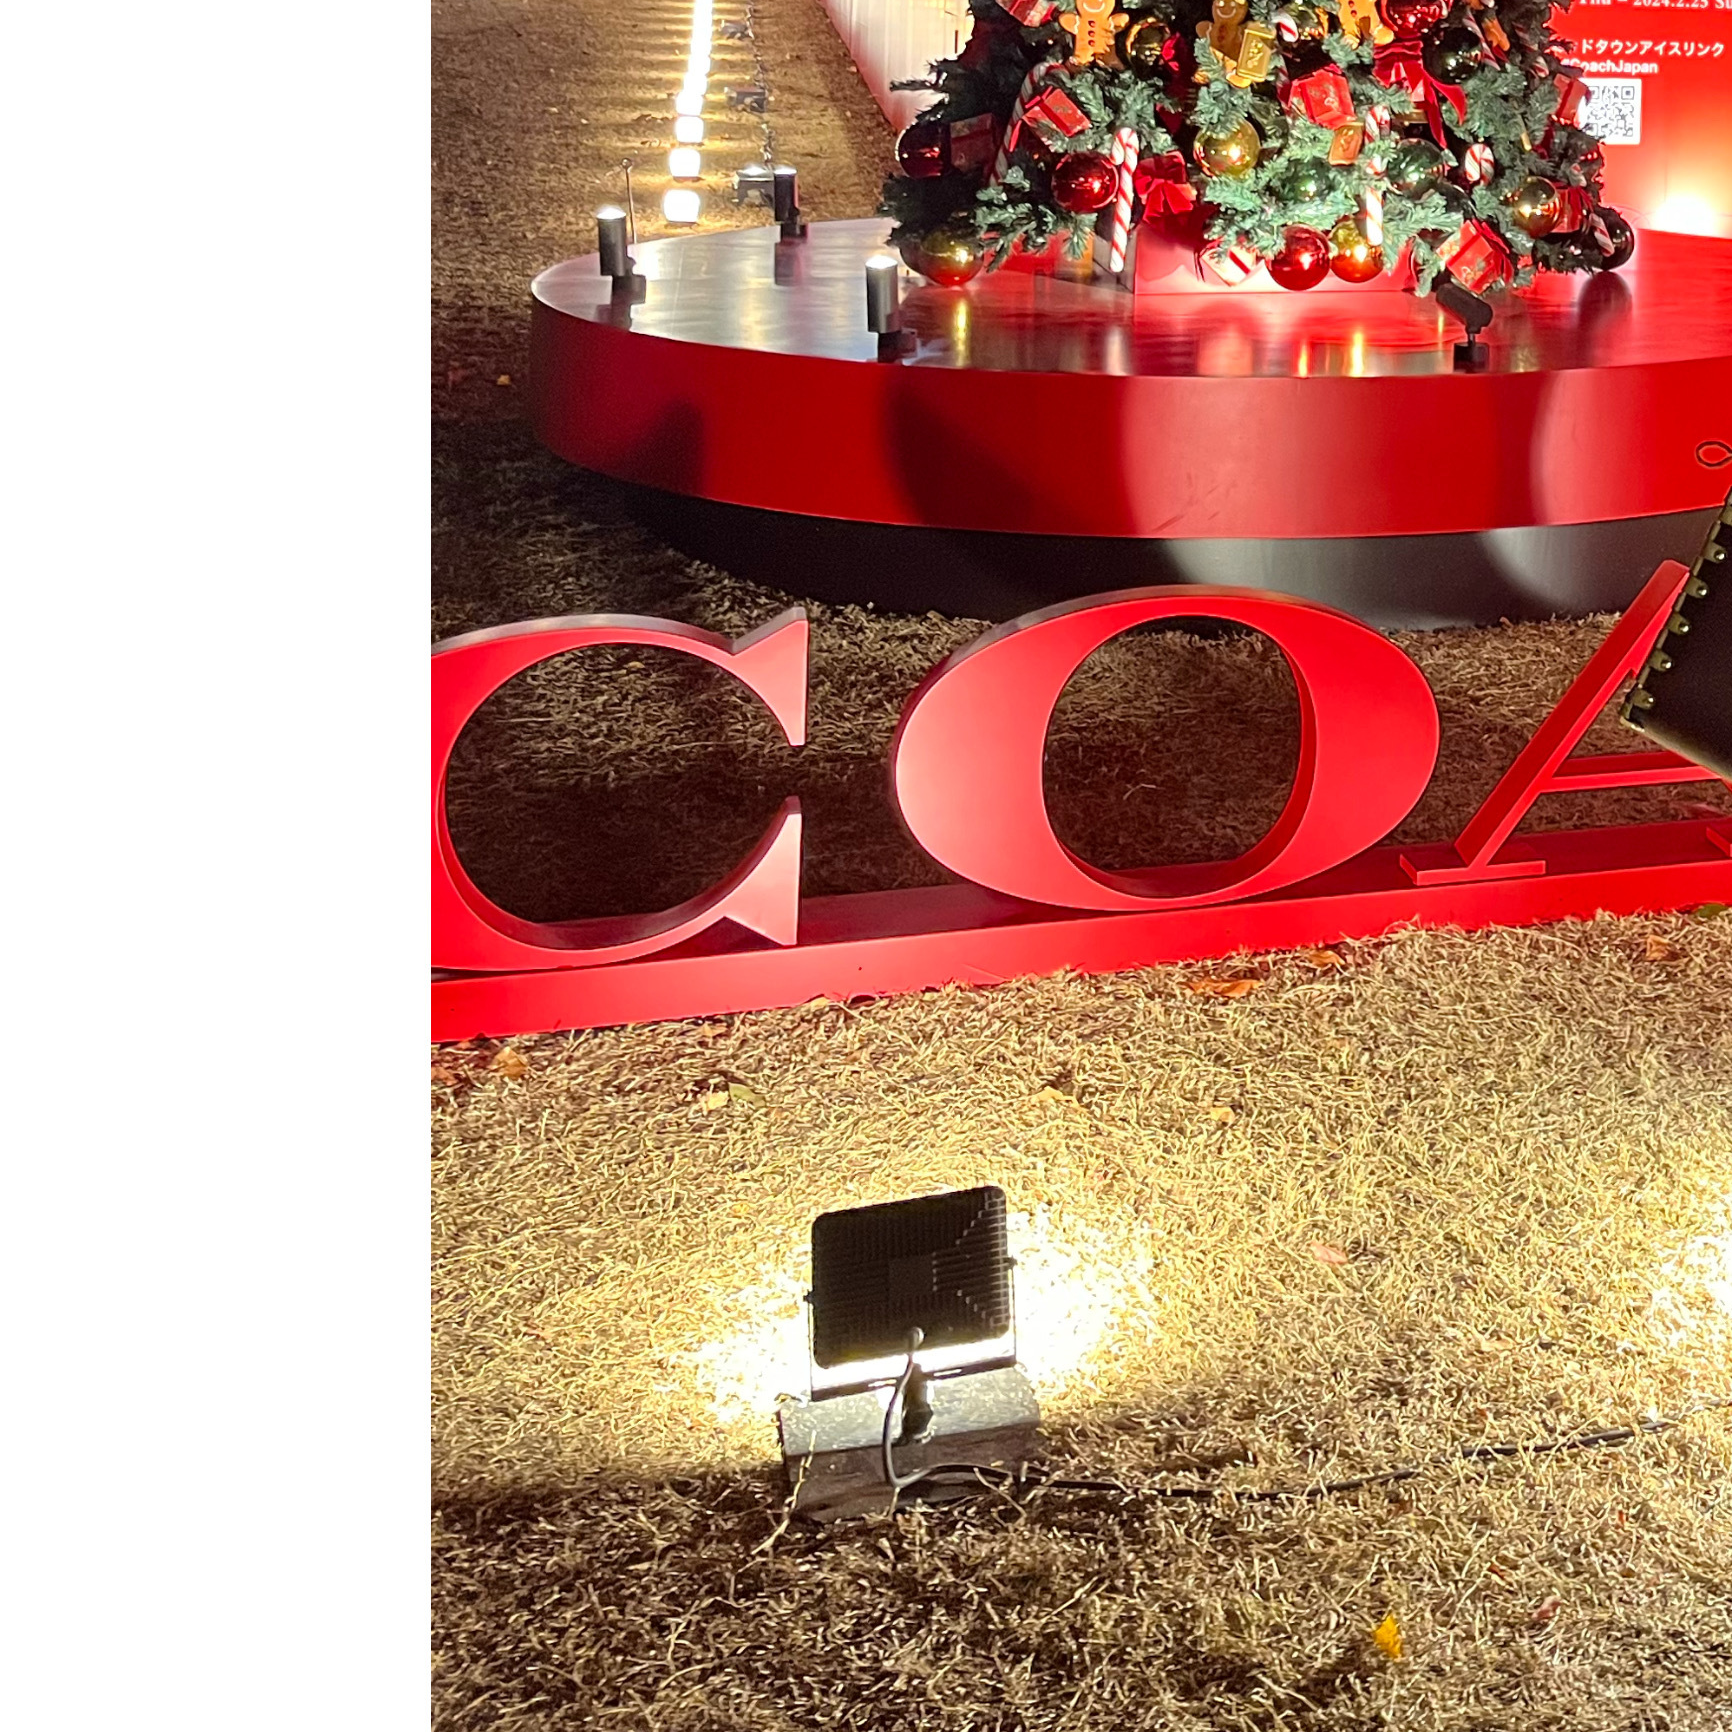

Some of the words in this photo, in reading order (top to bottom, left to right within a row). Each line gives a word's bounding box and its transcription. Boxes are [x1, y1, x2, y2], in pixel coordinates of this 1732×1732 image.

[1581, 38, 1725, 58] ドタウンアイスリンク
